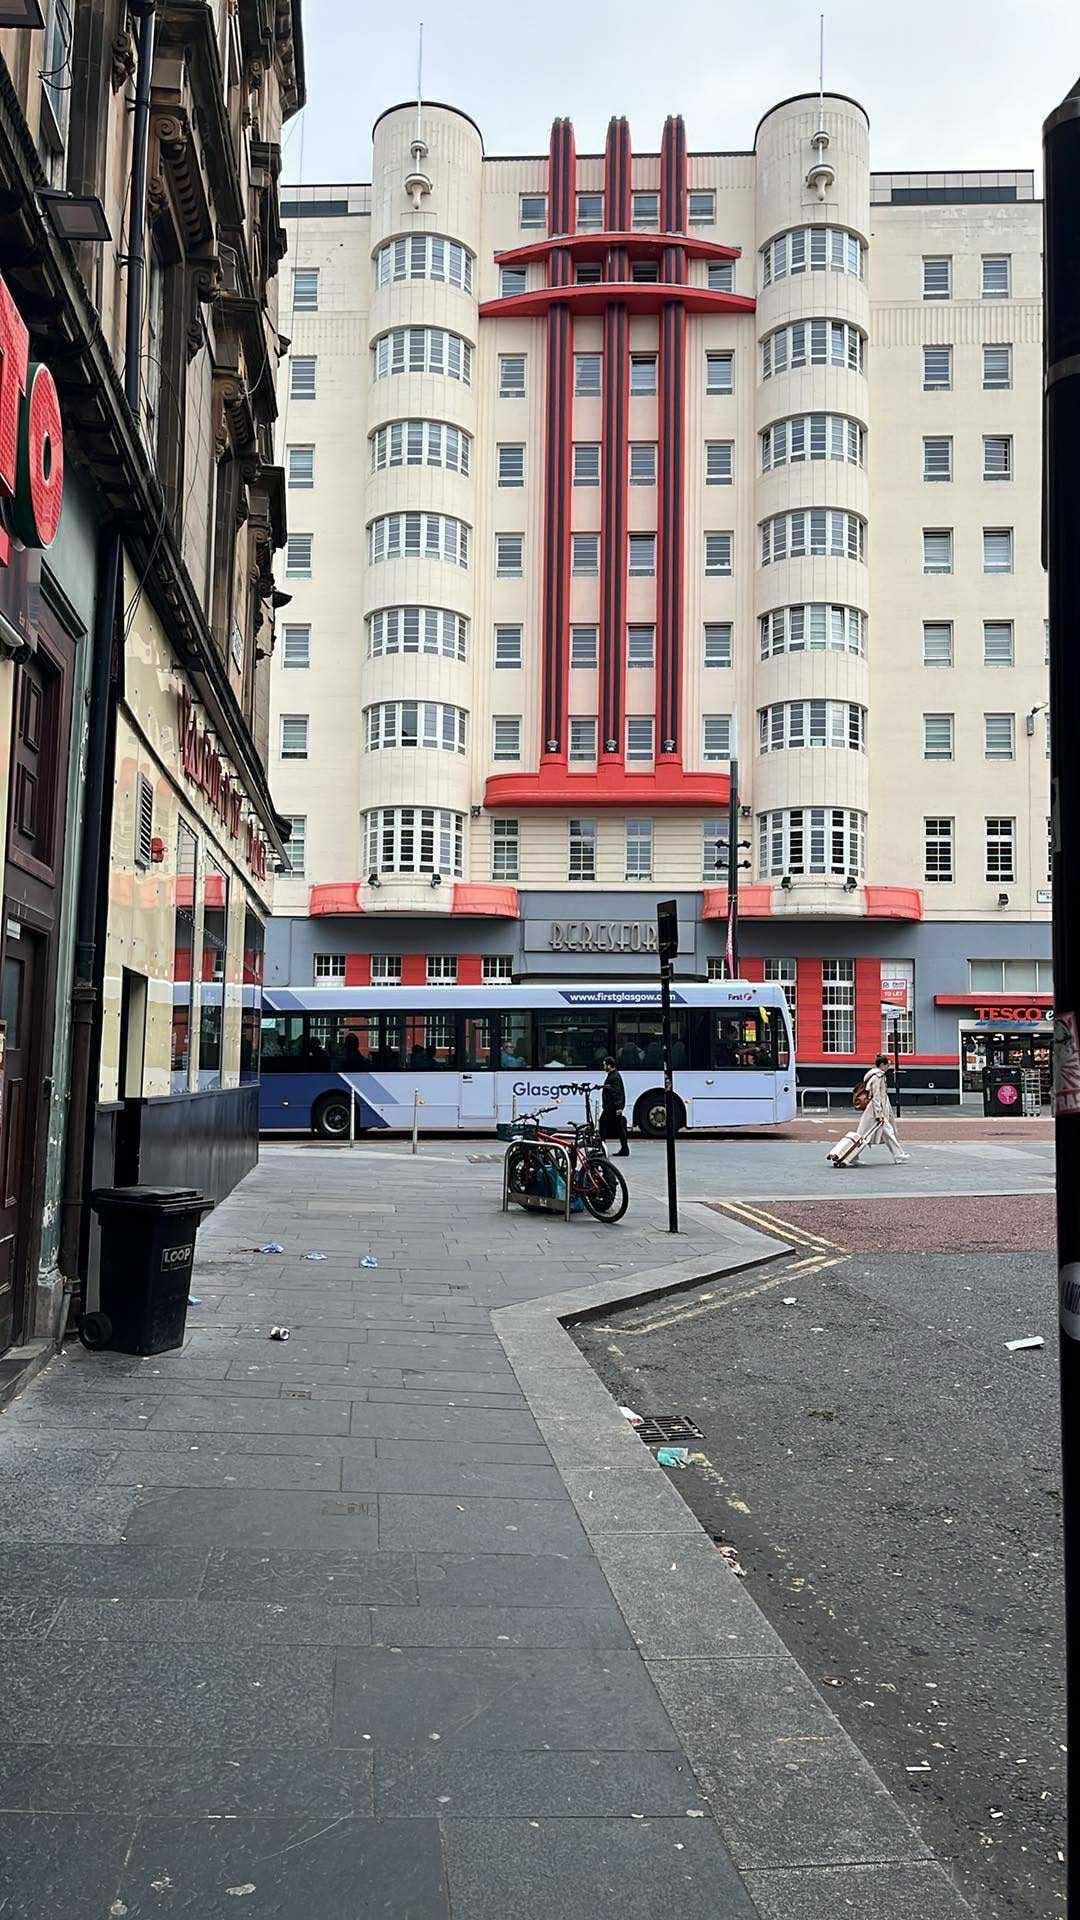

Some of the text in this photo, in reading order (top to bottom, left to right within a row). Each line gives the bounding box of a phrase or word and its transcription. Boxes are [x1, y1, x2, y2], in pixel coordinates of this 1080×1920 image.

[549, 922, 659, 951] BERESFOR
[570, 992, 676, 1003] www.firstglasgow.cm
[974, 1007, 1042, 1021] TESCO
[512, 1082, 587, 1100] Glasgow
[164, 1248, 191, 1264] LOOP
